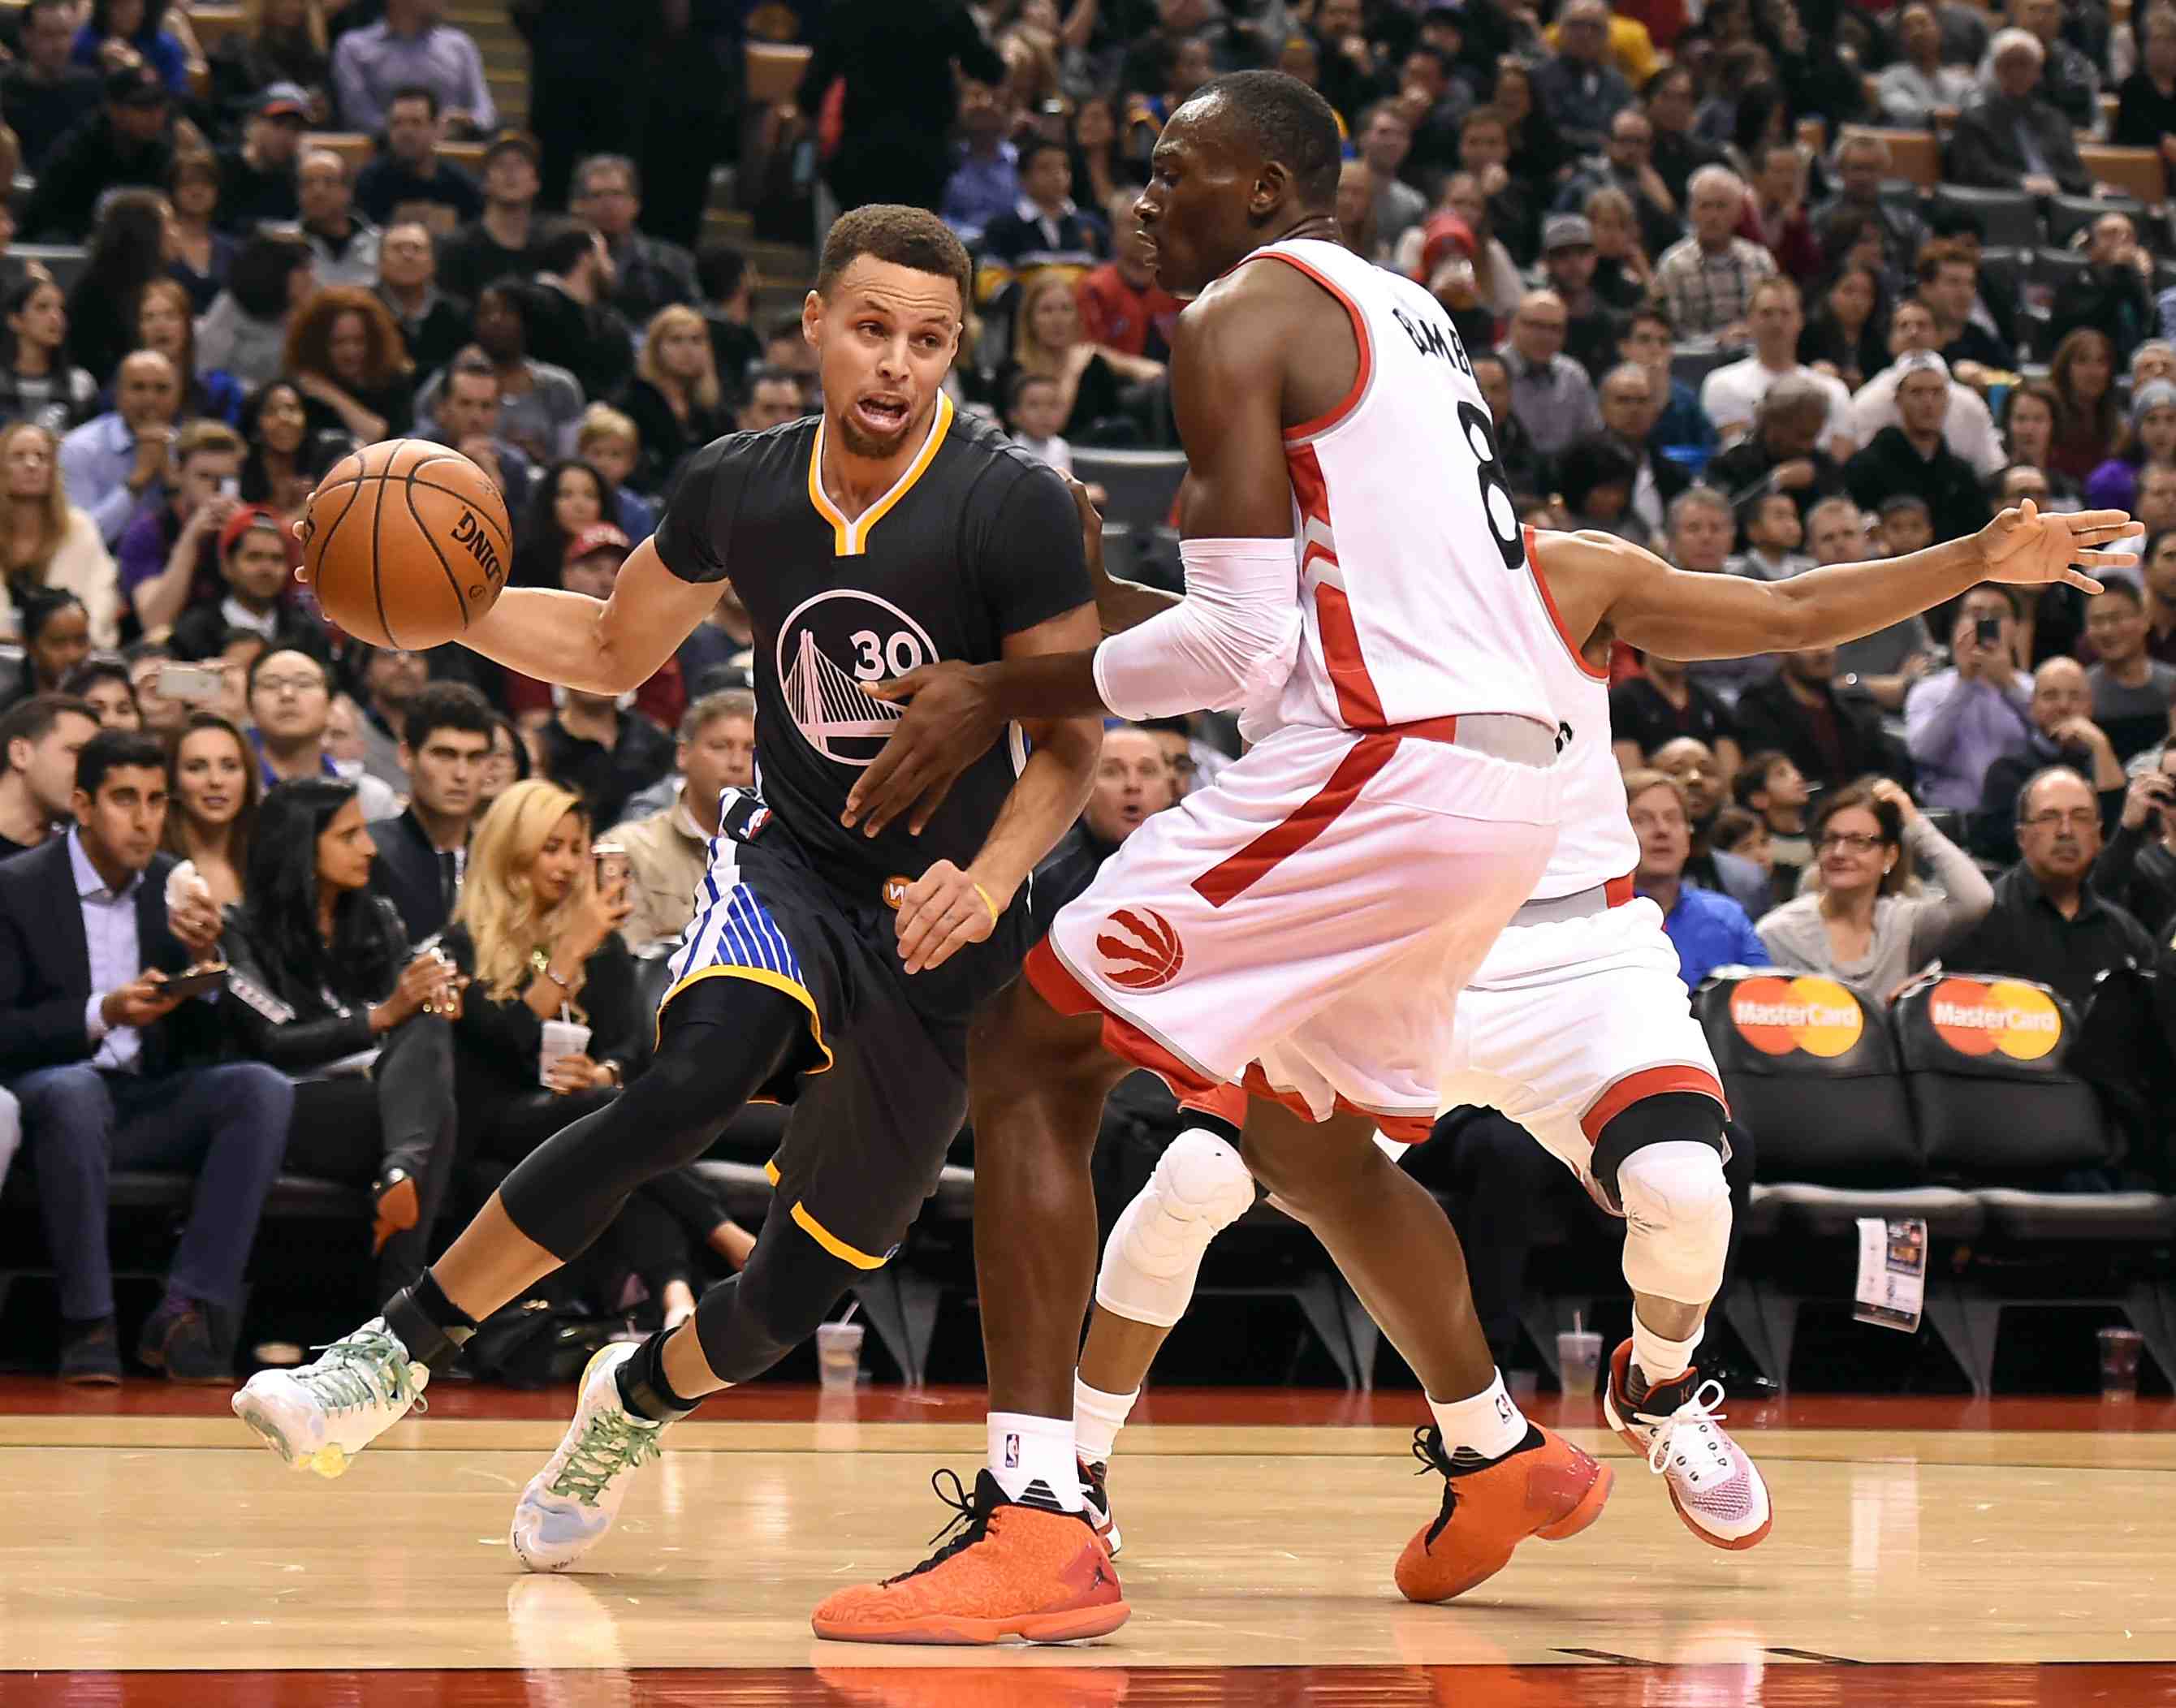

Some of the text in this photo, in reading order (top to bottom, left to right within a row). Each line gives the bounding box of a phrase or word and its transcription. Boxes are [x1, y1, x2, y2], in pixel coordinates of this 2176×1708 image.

[1457, 401, 1526, 570] 8
[850, 630, 922, 681] 30
[1735, 1001, 1859, 1027] MasterCard
[1934, 1003, 2057, 1032] MasterCard
